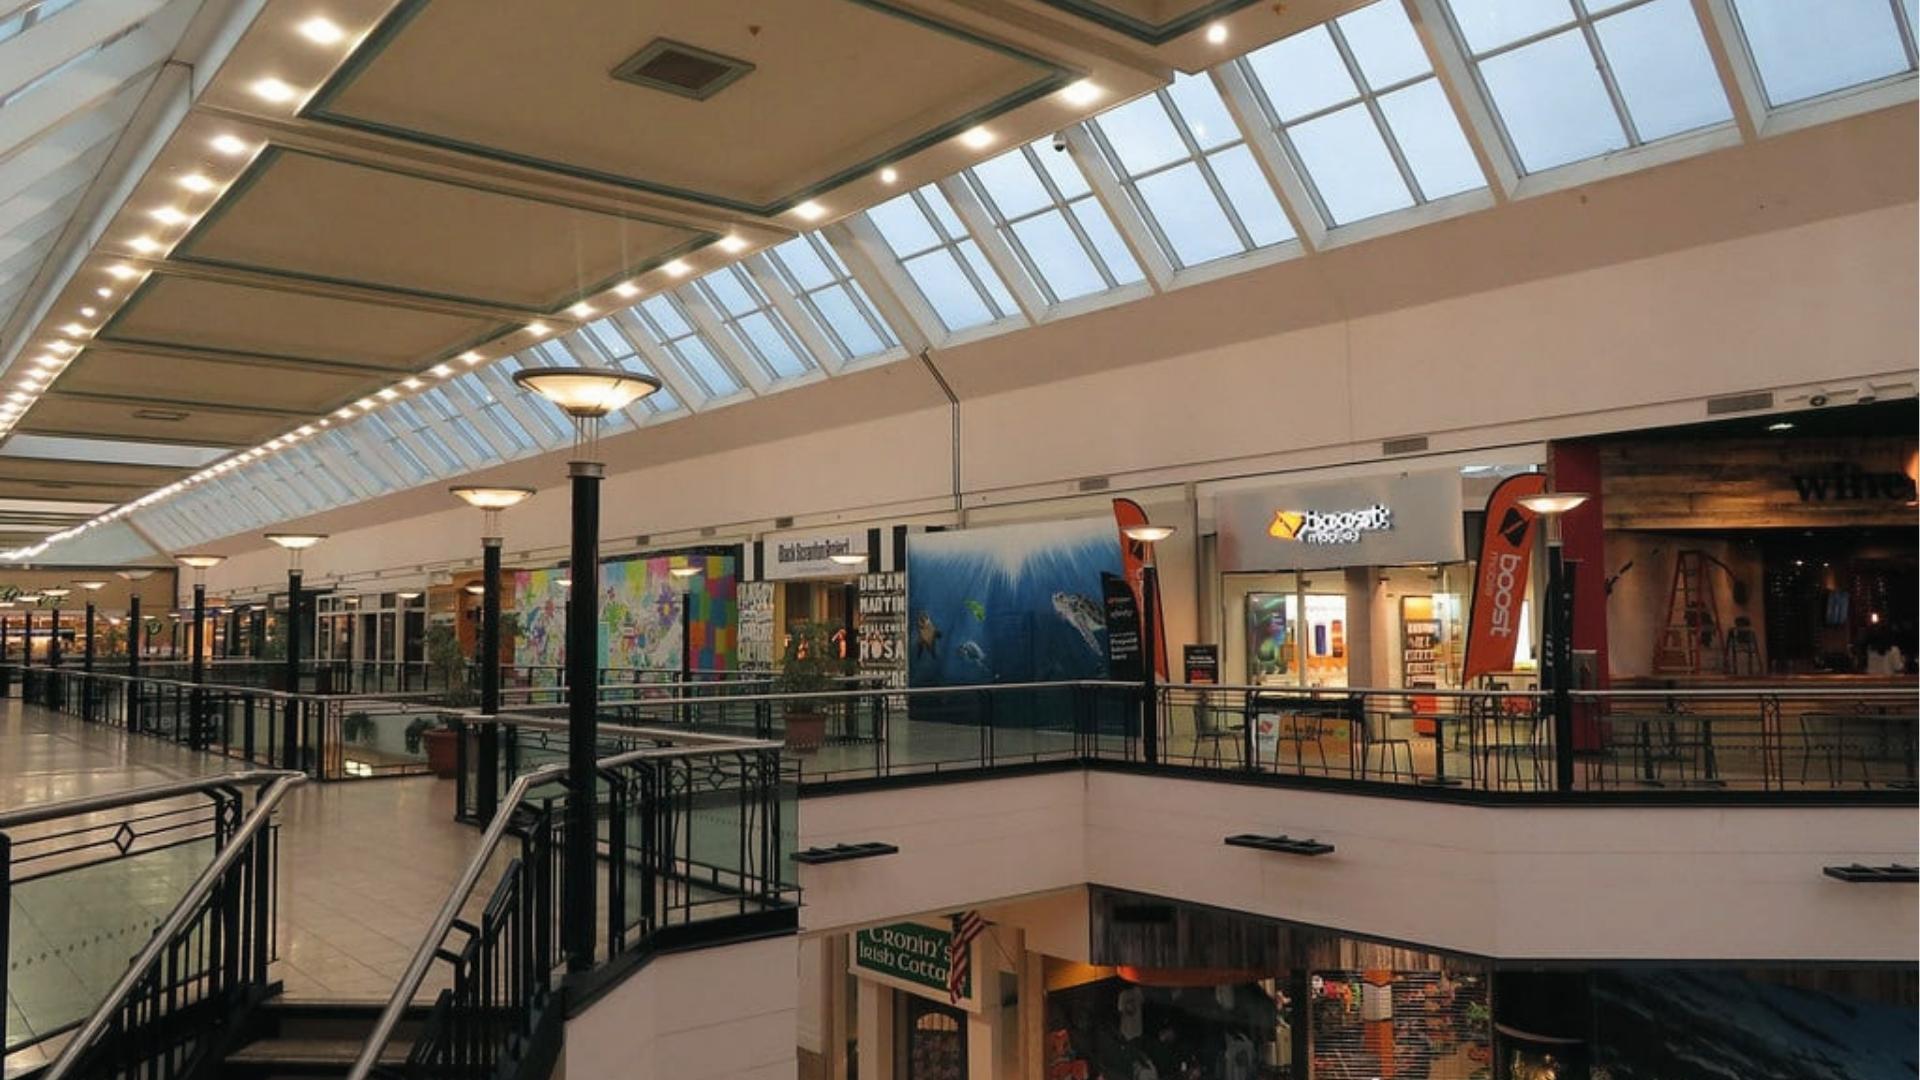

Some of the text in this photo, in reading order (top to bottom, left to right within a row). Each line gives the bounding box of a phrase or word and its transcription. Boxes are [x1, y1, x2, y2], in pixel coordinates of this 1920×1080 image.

[1306, 505, 1390, 530] boost
[859, 573, 905, 591] DREAM
[859, 596, 905, 613] MARTIN
[1489, 554, 1522, 637] boost
[859, 640, 905, 660] ROSA
[860, 941, 895, 966] Irish
